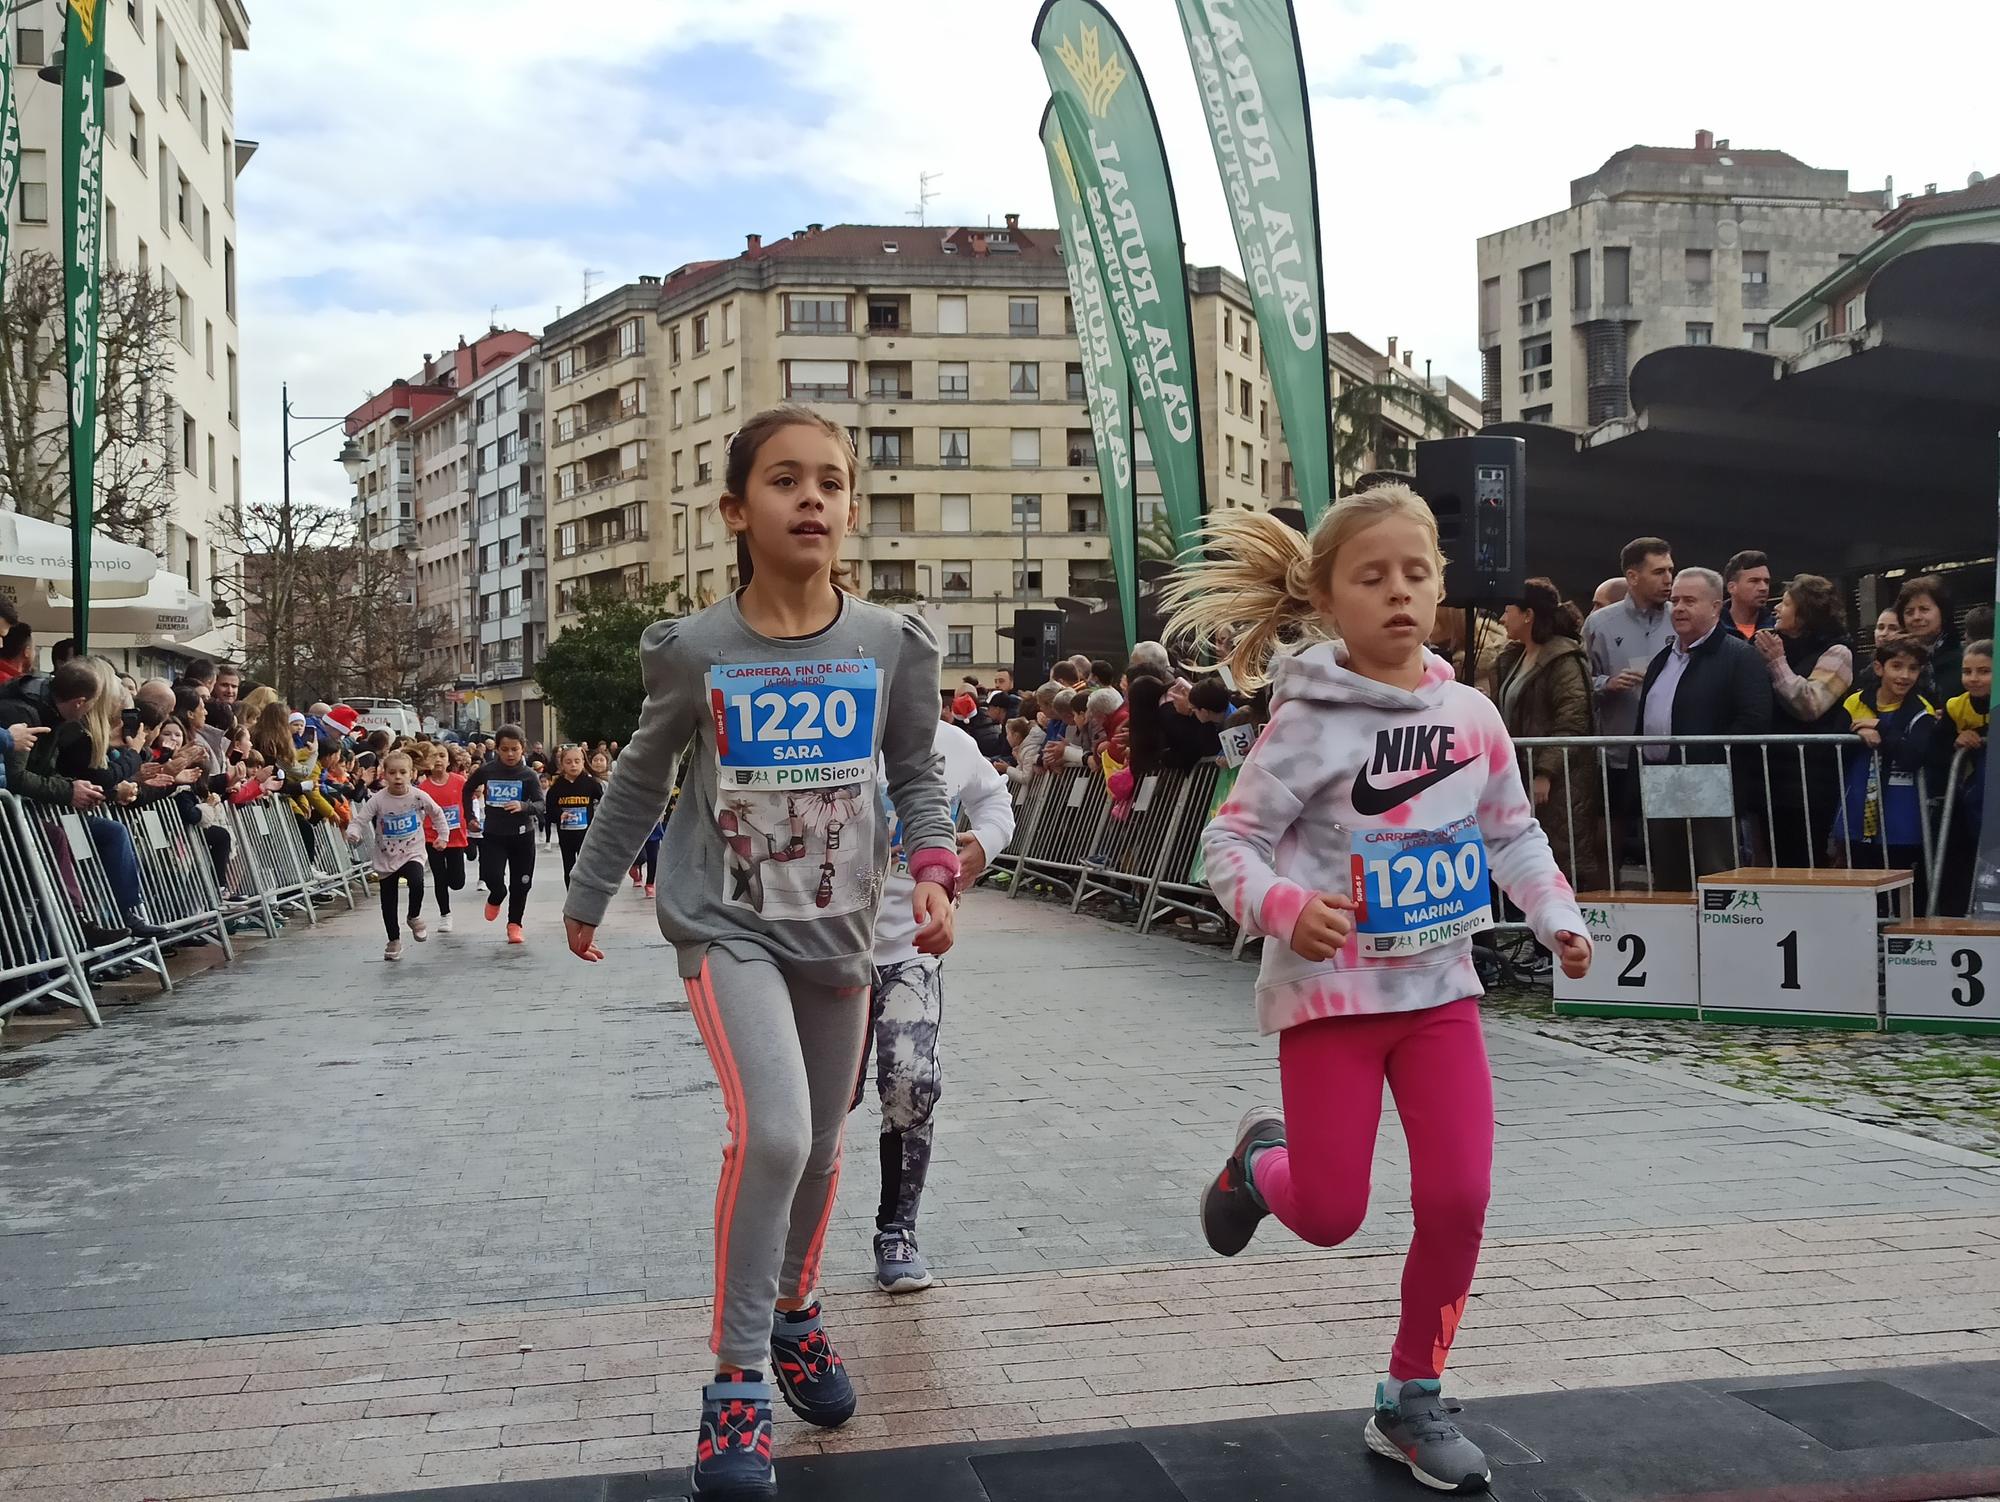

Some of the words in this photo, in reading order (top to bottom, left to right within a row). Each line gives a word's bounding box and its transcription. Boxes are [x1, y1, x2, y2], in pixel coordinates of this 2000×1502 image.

[76, 60, 94, 272] RURAL
[73, 286, 88, 428] CAJA
[91, 558, 131, 571] mpio
[727, 666, 791, 678] CARRERA
[796, 664, 813, 676] FIN
[817, 664, 832, 673] DE
[836, 661, 860, 673] AÑO
[731, 690, 857, 742] 1220
[773, 745, 823, 760] SARA
[1371, 725, 1455, 776] NIKE
[777, 767, 859, 784] PDMSiero
[489, 787, 518, 798] 1248
[387, 817, 413, 831] 1183
[445, 810, 457, 821] 22
[1369, 843, 1481, 908] 1200
[1404, 900, 1464, 925] MARINA
[1704, 913, 1764, 925] PDMSiero
[1419, 916, 1480, 946] PDMSiero
[1590, 932, 1612, 942] iero
[1617, 934, 1647, 987] 2
[1776, 930, 1801, 989] 1
[1888, 957, 1937, 966] PDMSiero
[1951, 948, 1985, 1007] 3
